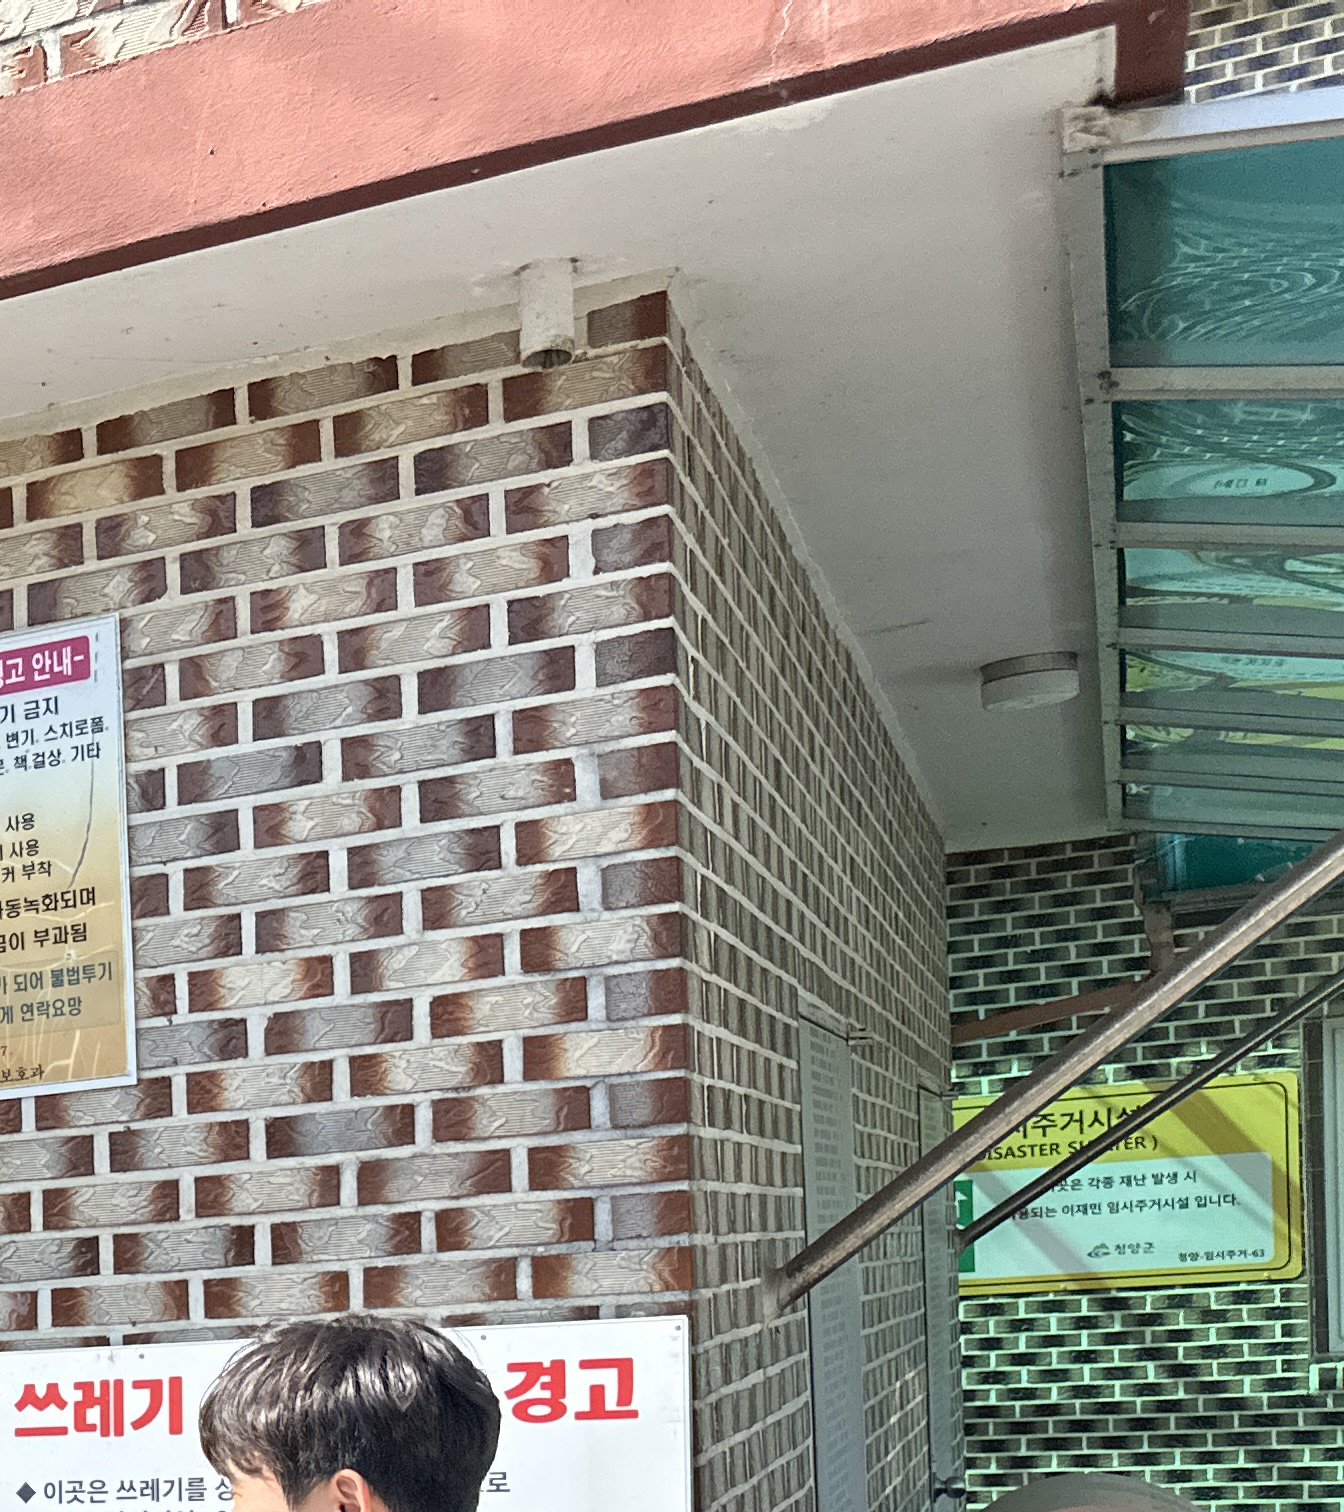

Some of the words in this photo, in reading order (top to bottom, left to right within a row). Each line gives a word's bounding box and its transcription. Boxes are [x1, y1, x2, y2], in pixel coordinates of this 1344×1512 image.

[24, 696, 59, 720] 금지
[71, 742, 101, 761] 기타
[6, 812, 35, 832] 사용
[9, 839, 39, 859] 사용
[22, 861, 52, 880] 부착
[33, 922, 88, 946] 부과됨
[14, 970, 44, 992] 되어
[50, 961, 112, 988] 불법투기
[20, 997, 82, 1022] 연락요망
[1119, 1172, 1147, 1187] 재난
[1152, 1171, 1179, 1185] 발생
[1184, 1169, 1197, 1183] 시
[14, 1375, 183, 1438] 쓰레기
[503, 1357, 639, 1424] 경고
[43, 1479, 109, 1504] 이곳은
[116, 1477, 207, 1502] 쓰레기를
